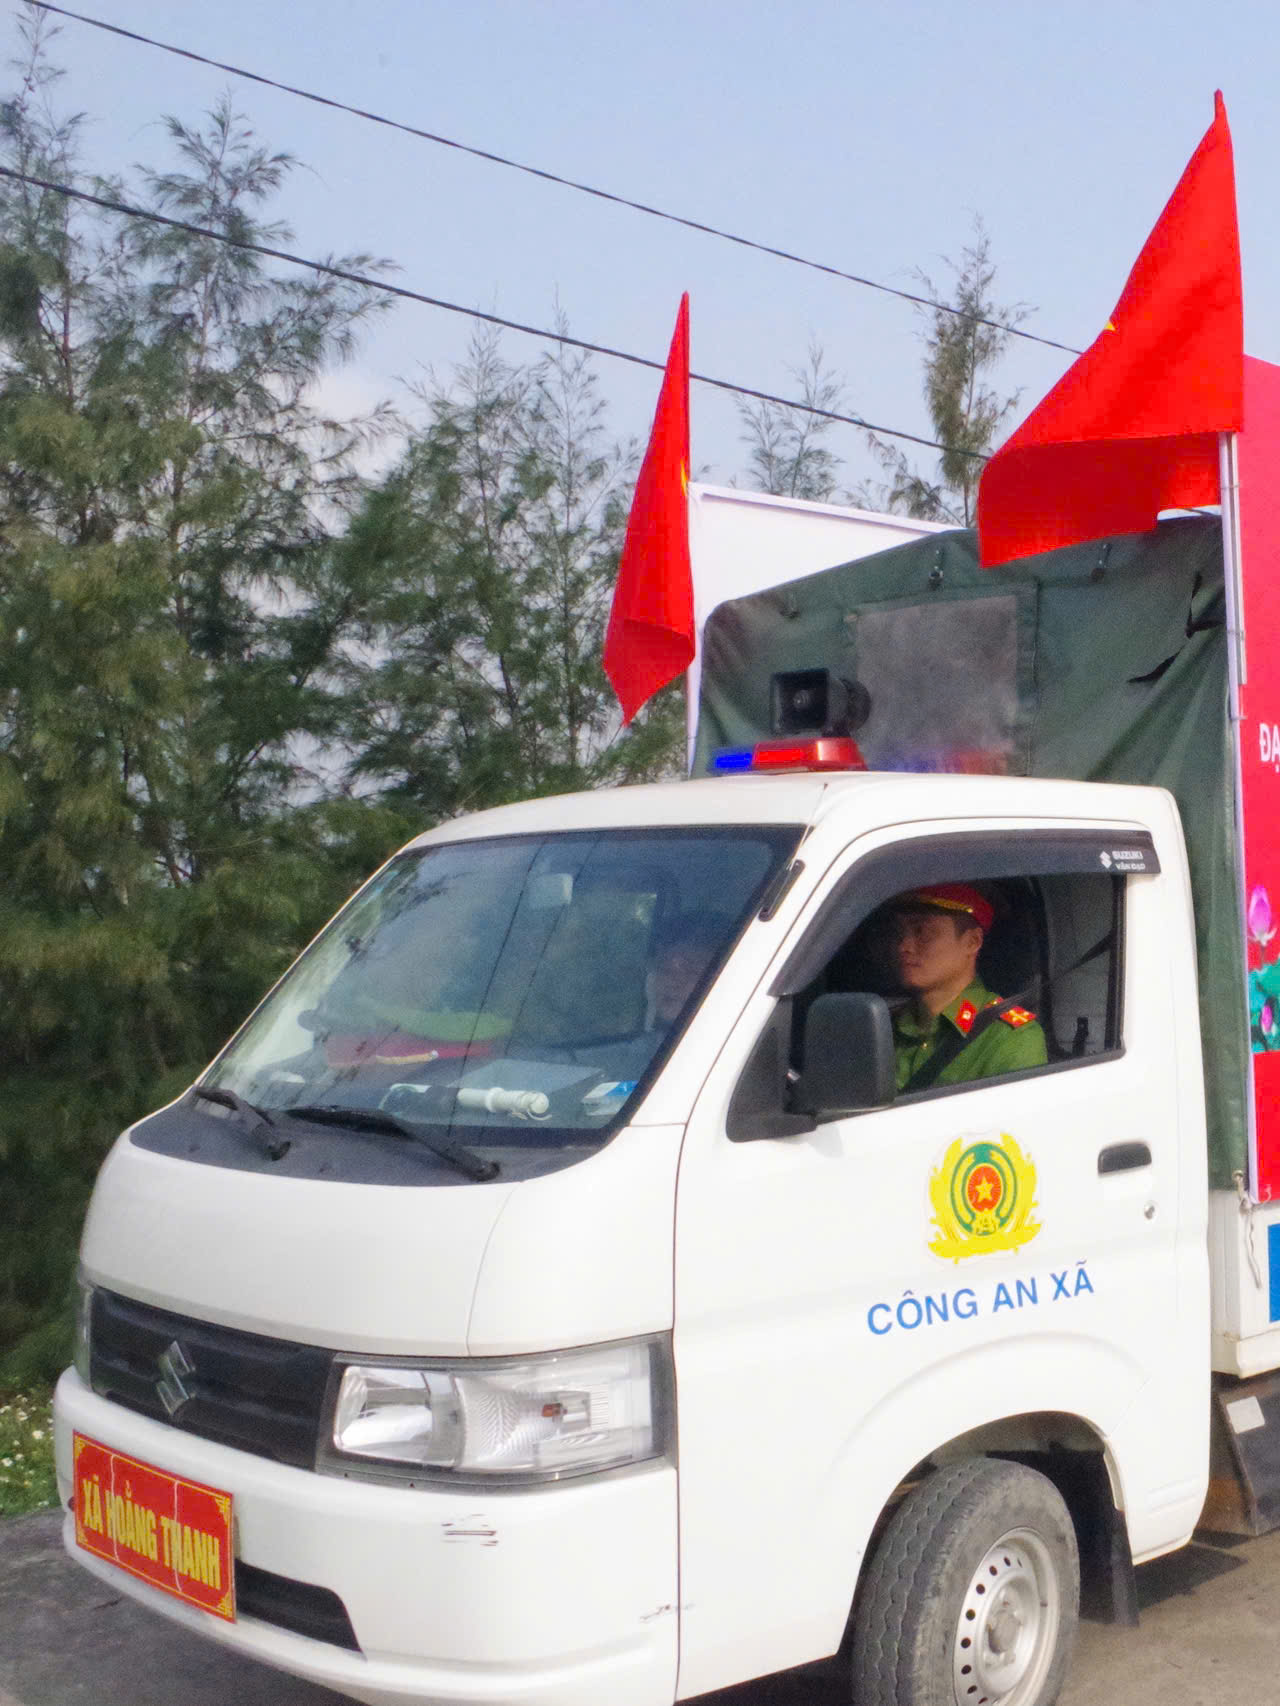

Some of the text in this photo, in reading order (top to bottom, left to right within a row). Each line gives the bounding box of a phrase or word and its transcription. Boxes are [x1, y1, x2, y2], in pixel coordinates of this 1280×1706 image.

[867, 1259, 1094, 1335] CÔNG AN XÃ
[83, 1474, 103, 1534] XÃ
[160, 1515, 221, 1590] THANH
